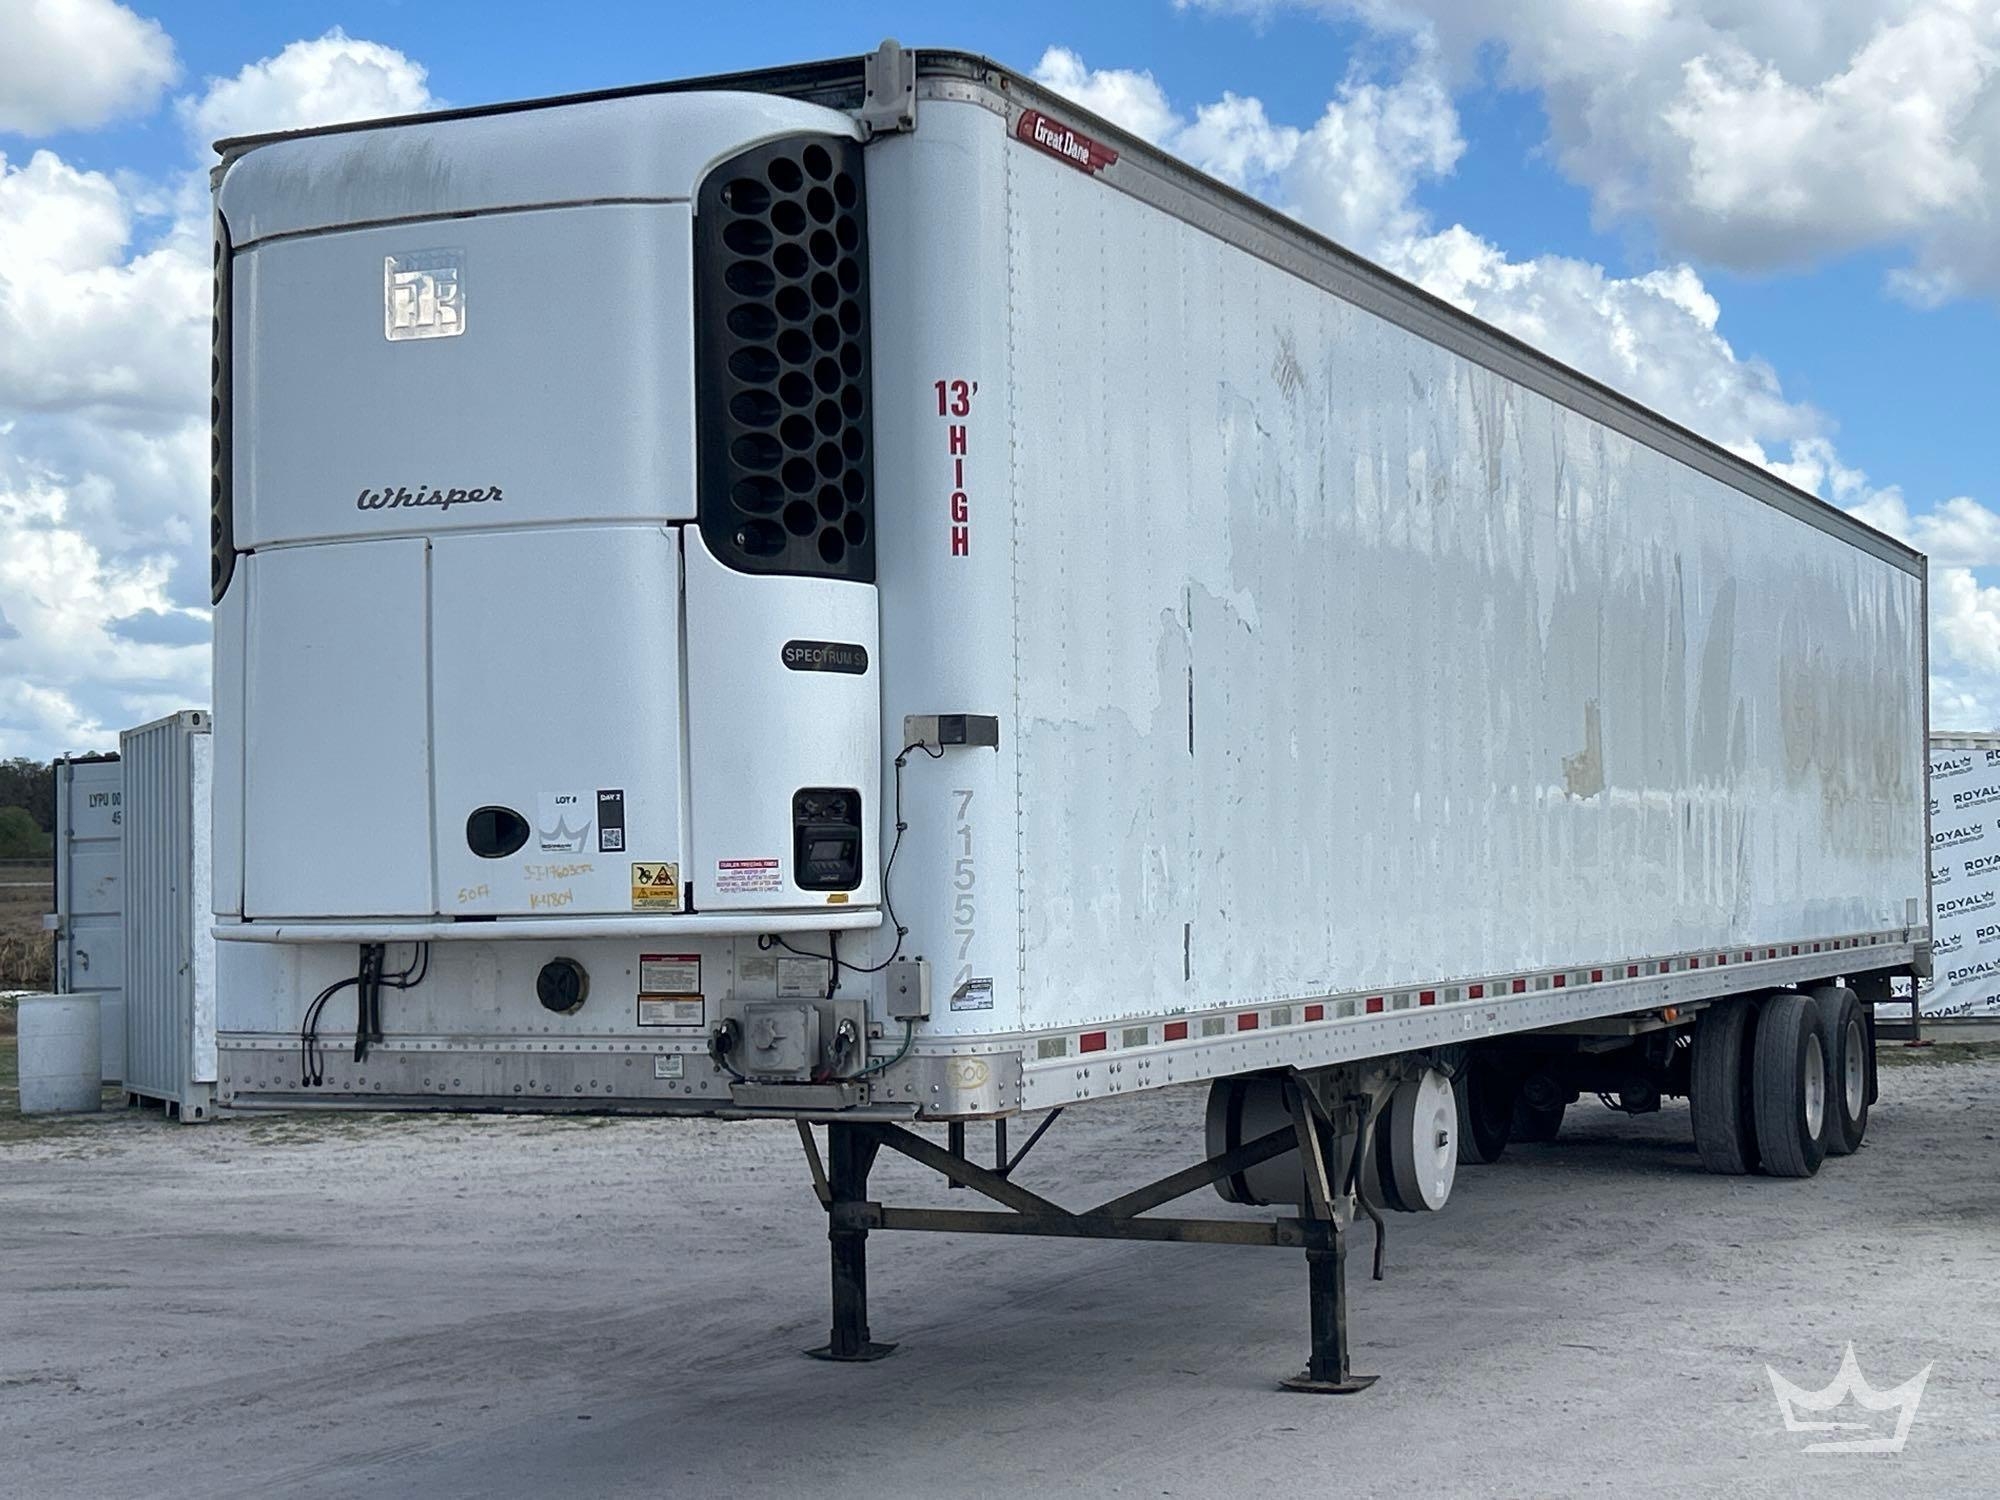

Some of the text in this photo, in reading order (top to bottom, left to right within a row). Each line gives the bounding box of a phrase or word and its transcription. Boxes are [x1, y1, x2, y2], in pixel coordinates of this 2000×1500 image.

[1034, 116, 1089, 165] Great Dane
[934, 380, 978, 557] 13' HIGH
[357, 485, 503, 511] Whisper
[785, 648, 852, 665] SPECTRUM
[555, 796, 571, 804] LOT
[1953, 786, 1999, 804] ROYAL
[1936, 895, 1983, 913] ROYAL
[1948, 962, 1995, 981] ROYAL
